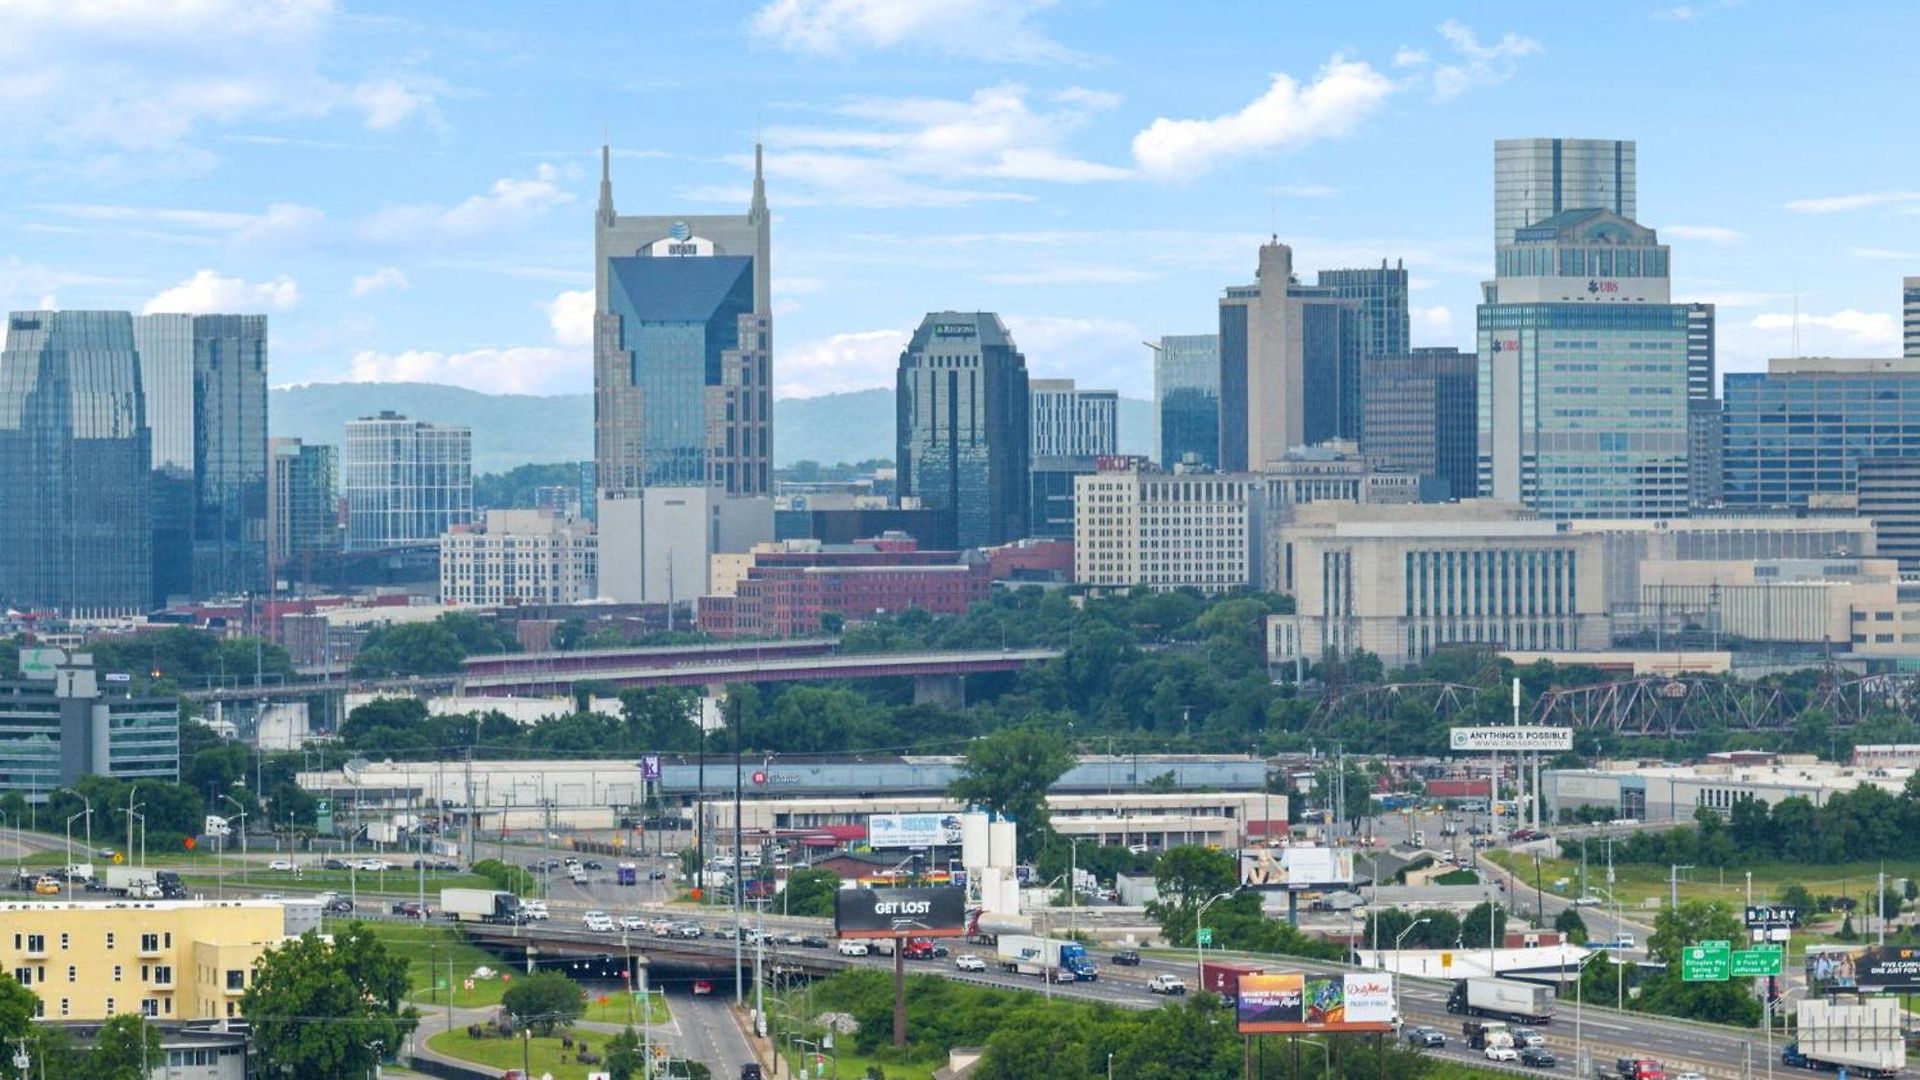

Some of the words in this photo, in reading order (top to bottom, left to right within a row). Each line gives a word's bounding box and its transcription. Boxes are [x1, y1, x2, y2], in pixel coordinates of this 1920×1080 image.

[1600, 281, 1618, 292] UBS
[875, 902, 898, 914] GET
[901, 901, 931, 913] LOST
